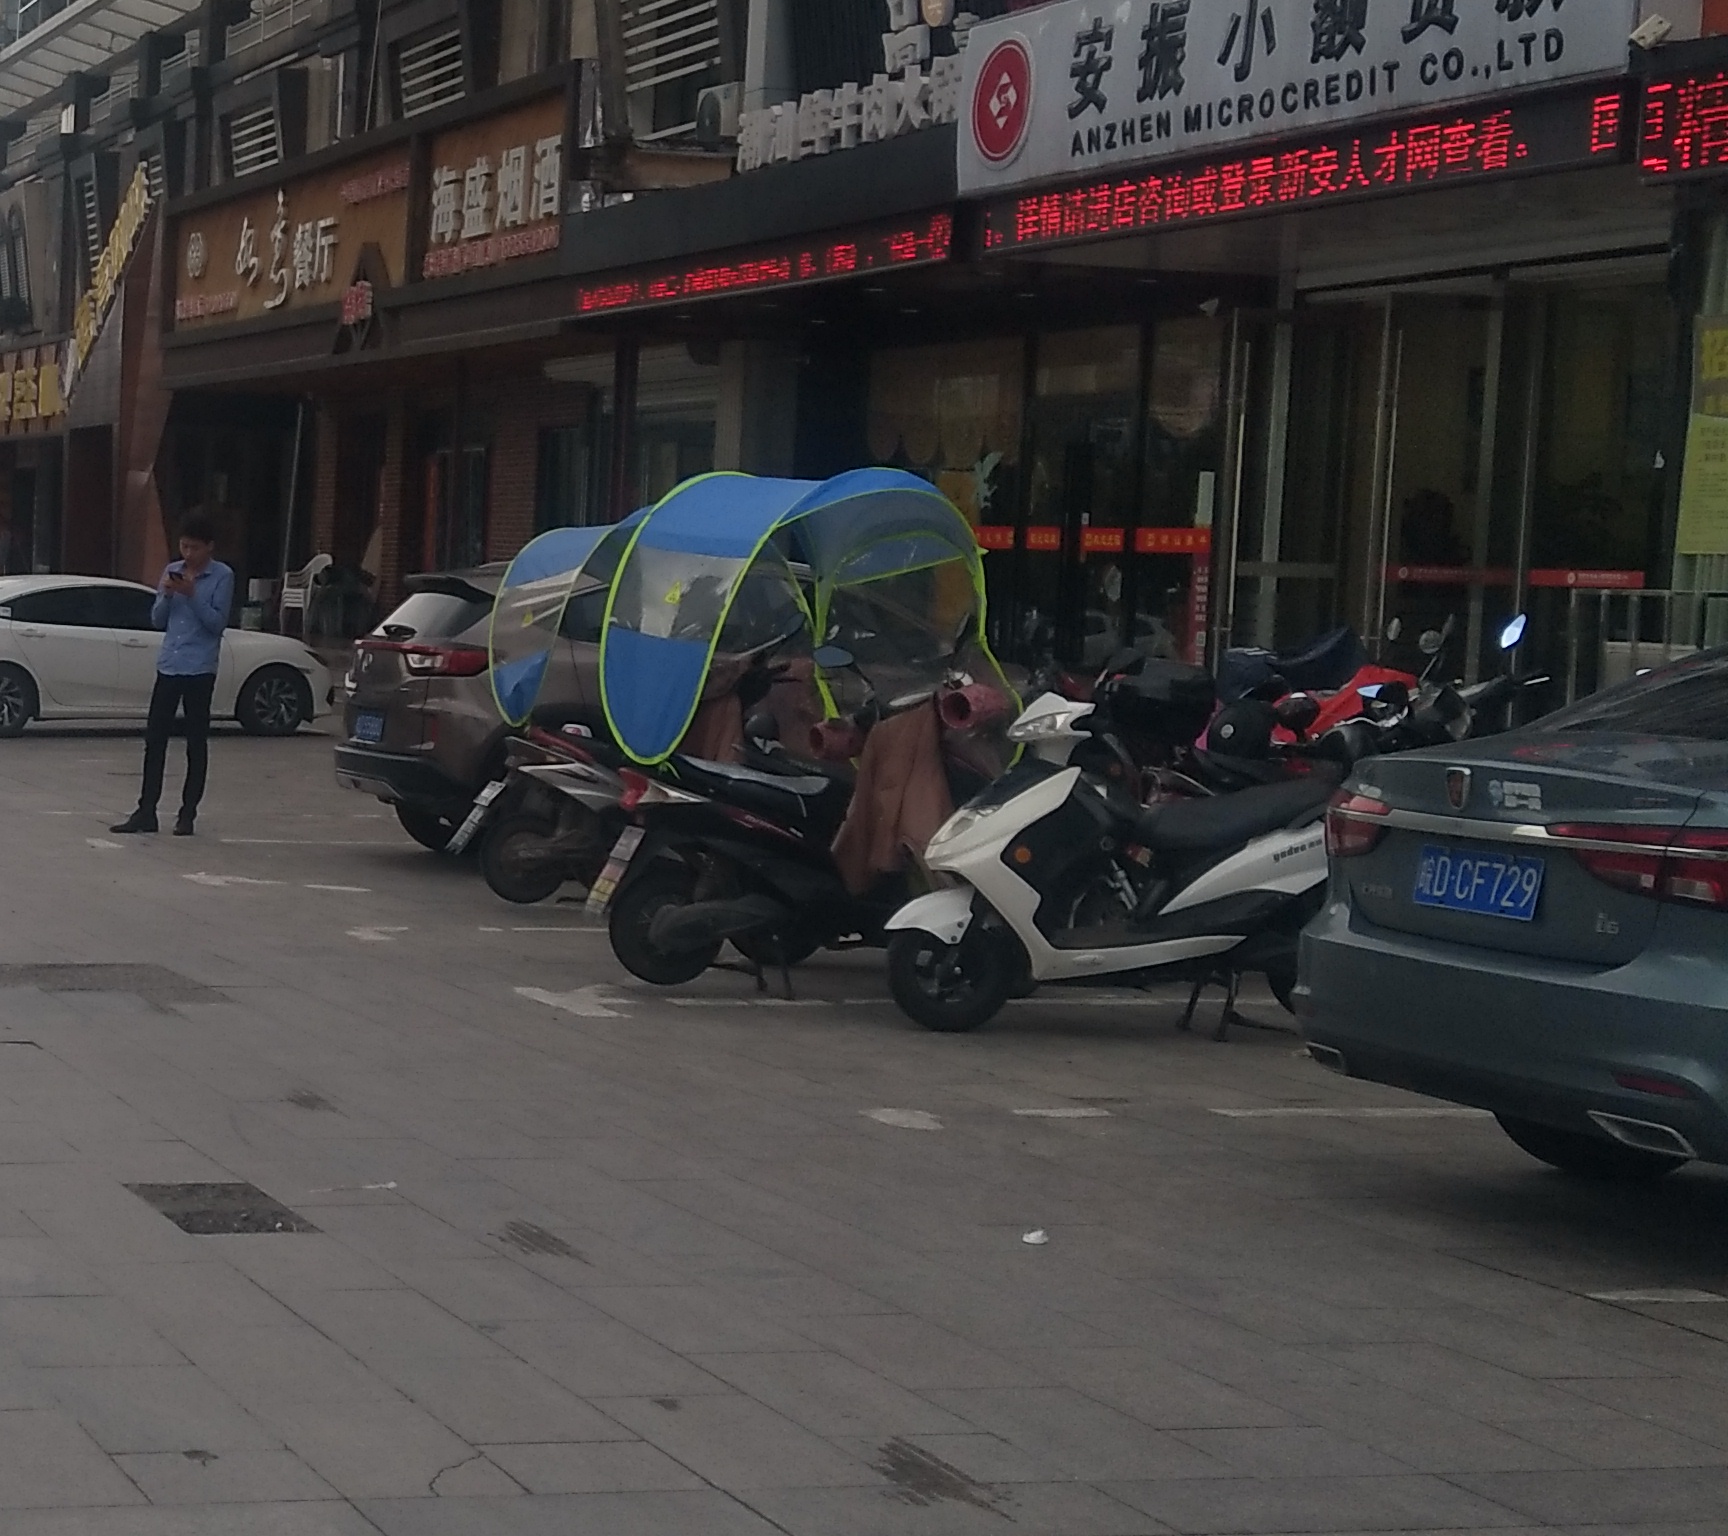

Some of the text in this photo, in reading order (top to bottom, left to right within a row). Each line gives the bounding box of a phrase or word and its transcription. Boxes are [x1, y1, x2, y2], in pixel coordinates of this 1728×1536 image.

[1071, 26, 1565, 158] ANZHEN MICROCREDIT CO.,LTD
[430, 134, 562, 244] 海盛烟酒
